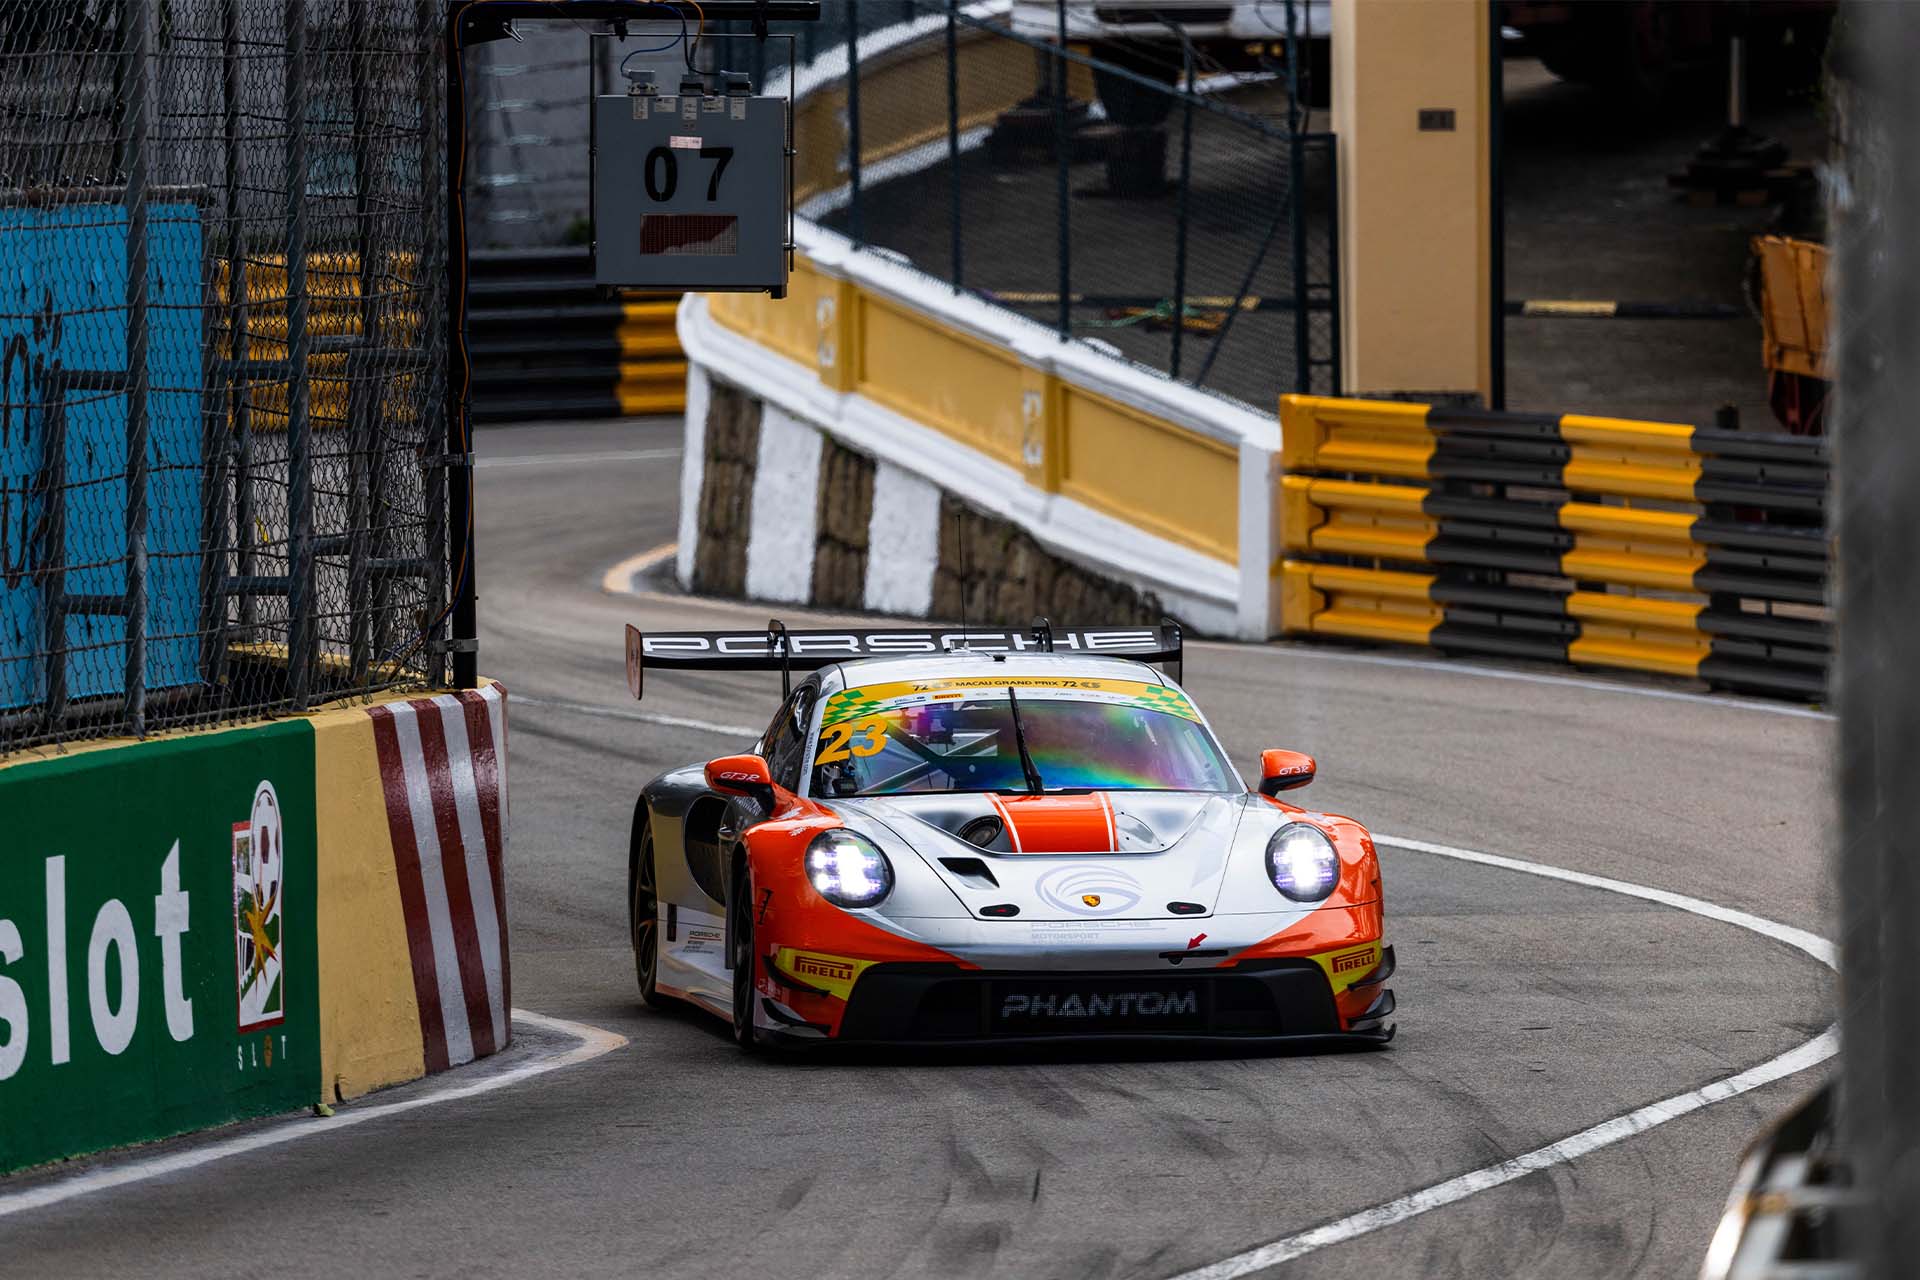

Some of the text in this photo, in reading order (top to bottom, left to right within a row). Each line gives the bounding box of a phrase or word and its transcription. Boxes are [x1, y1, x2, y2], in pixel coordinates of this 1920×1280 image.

[644, 146, 735, 202] 07
[642, 631, 1157, 653] PORSCHE
[912, 684, 929, 692] 72
[1061, 680, 1078, 688] 72
[814, 717, 889, 766] 23
[793, 955, 854, 981] PIRELLI
[1331, 947, 1376, 974] PIRELLI
[1002, 990, 1196, 1018] PHANTOM
